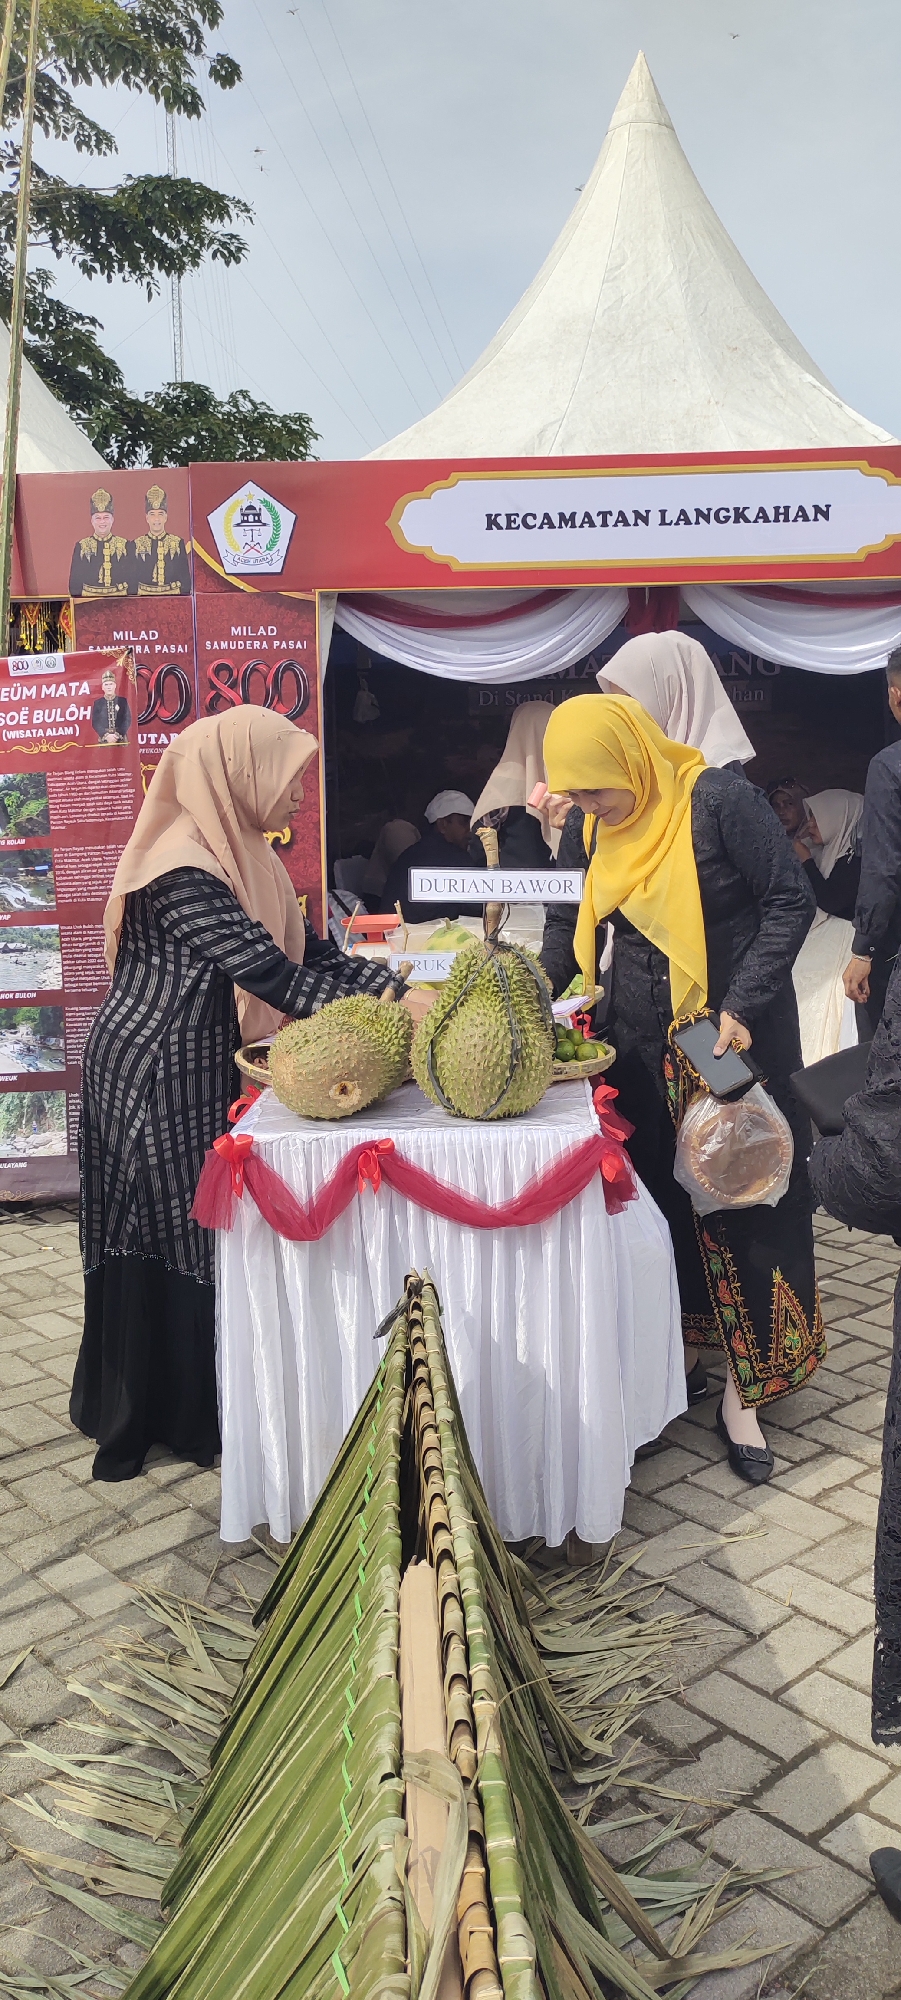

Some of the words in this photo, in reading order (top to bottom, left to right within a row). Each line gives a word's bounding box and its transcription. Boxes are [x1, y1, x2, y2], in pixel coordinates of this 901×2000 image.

[485, 509, 651, 531] KECAMATAN
[658, 504, 832, 527] LANGKAHAN
[113, 630, 159, 641] MILAD
[231, 625, 277, 636] MILAD
[155, 644, 188, 654] PASAI
[205, 640, 267, 650] SAMUDERA
[273, 640, 308, 650] PASAI
[41, 681, 91, 699] MATA
[32, 703, 92, 724] BULÔH
[2, 729, 44, 741] (WISATA
[418, 878, 495, 894] DURIAN
[500, 879, 576, 895] BAWOR
